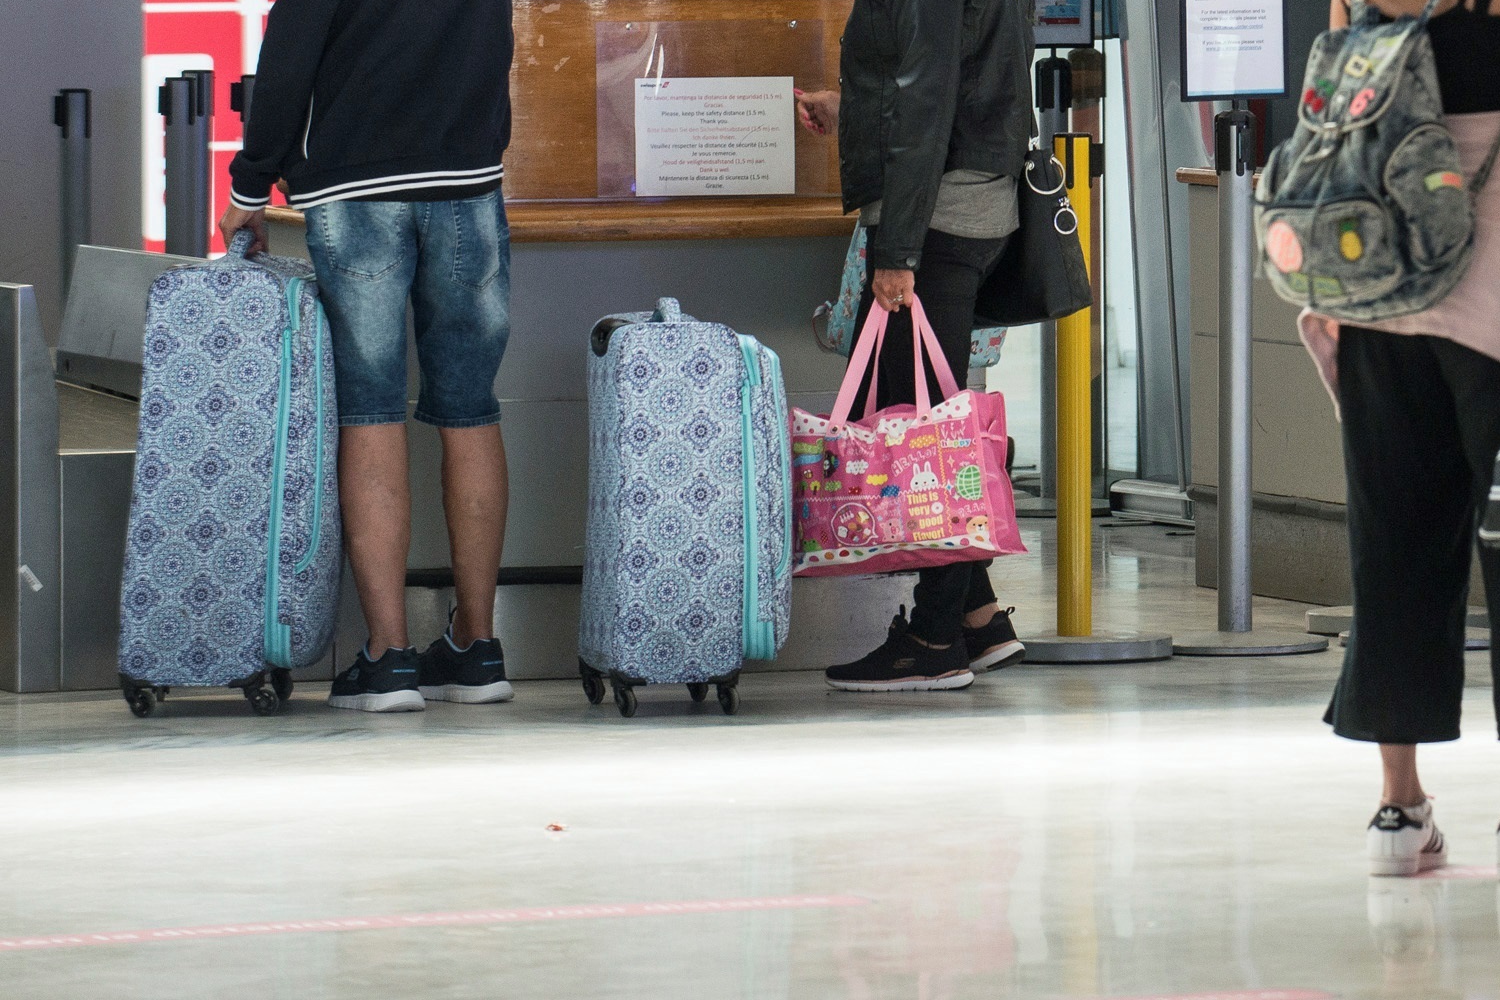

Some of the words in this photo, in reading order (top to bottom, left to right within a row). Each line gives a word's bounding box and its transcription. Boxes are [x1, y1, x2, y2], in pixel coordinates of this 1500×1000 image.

[907, 494, 928, 505] This
[908, 505, 930, 517] very
[919, 514, 943, 530] good
[913, 527, 945, 542] Flavor!
